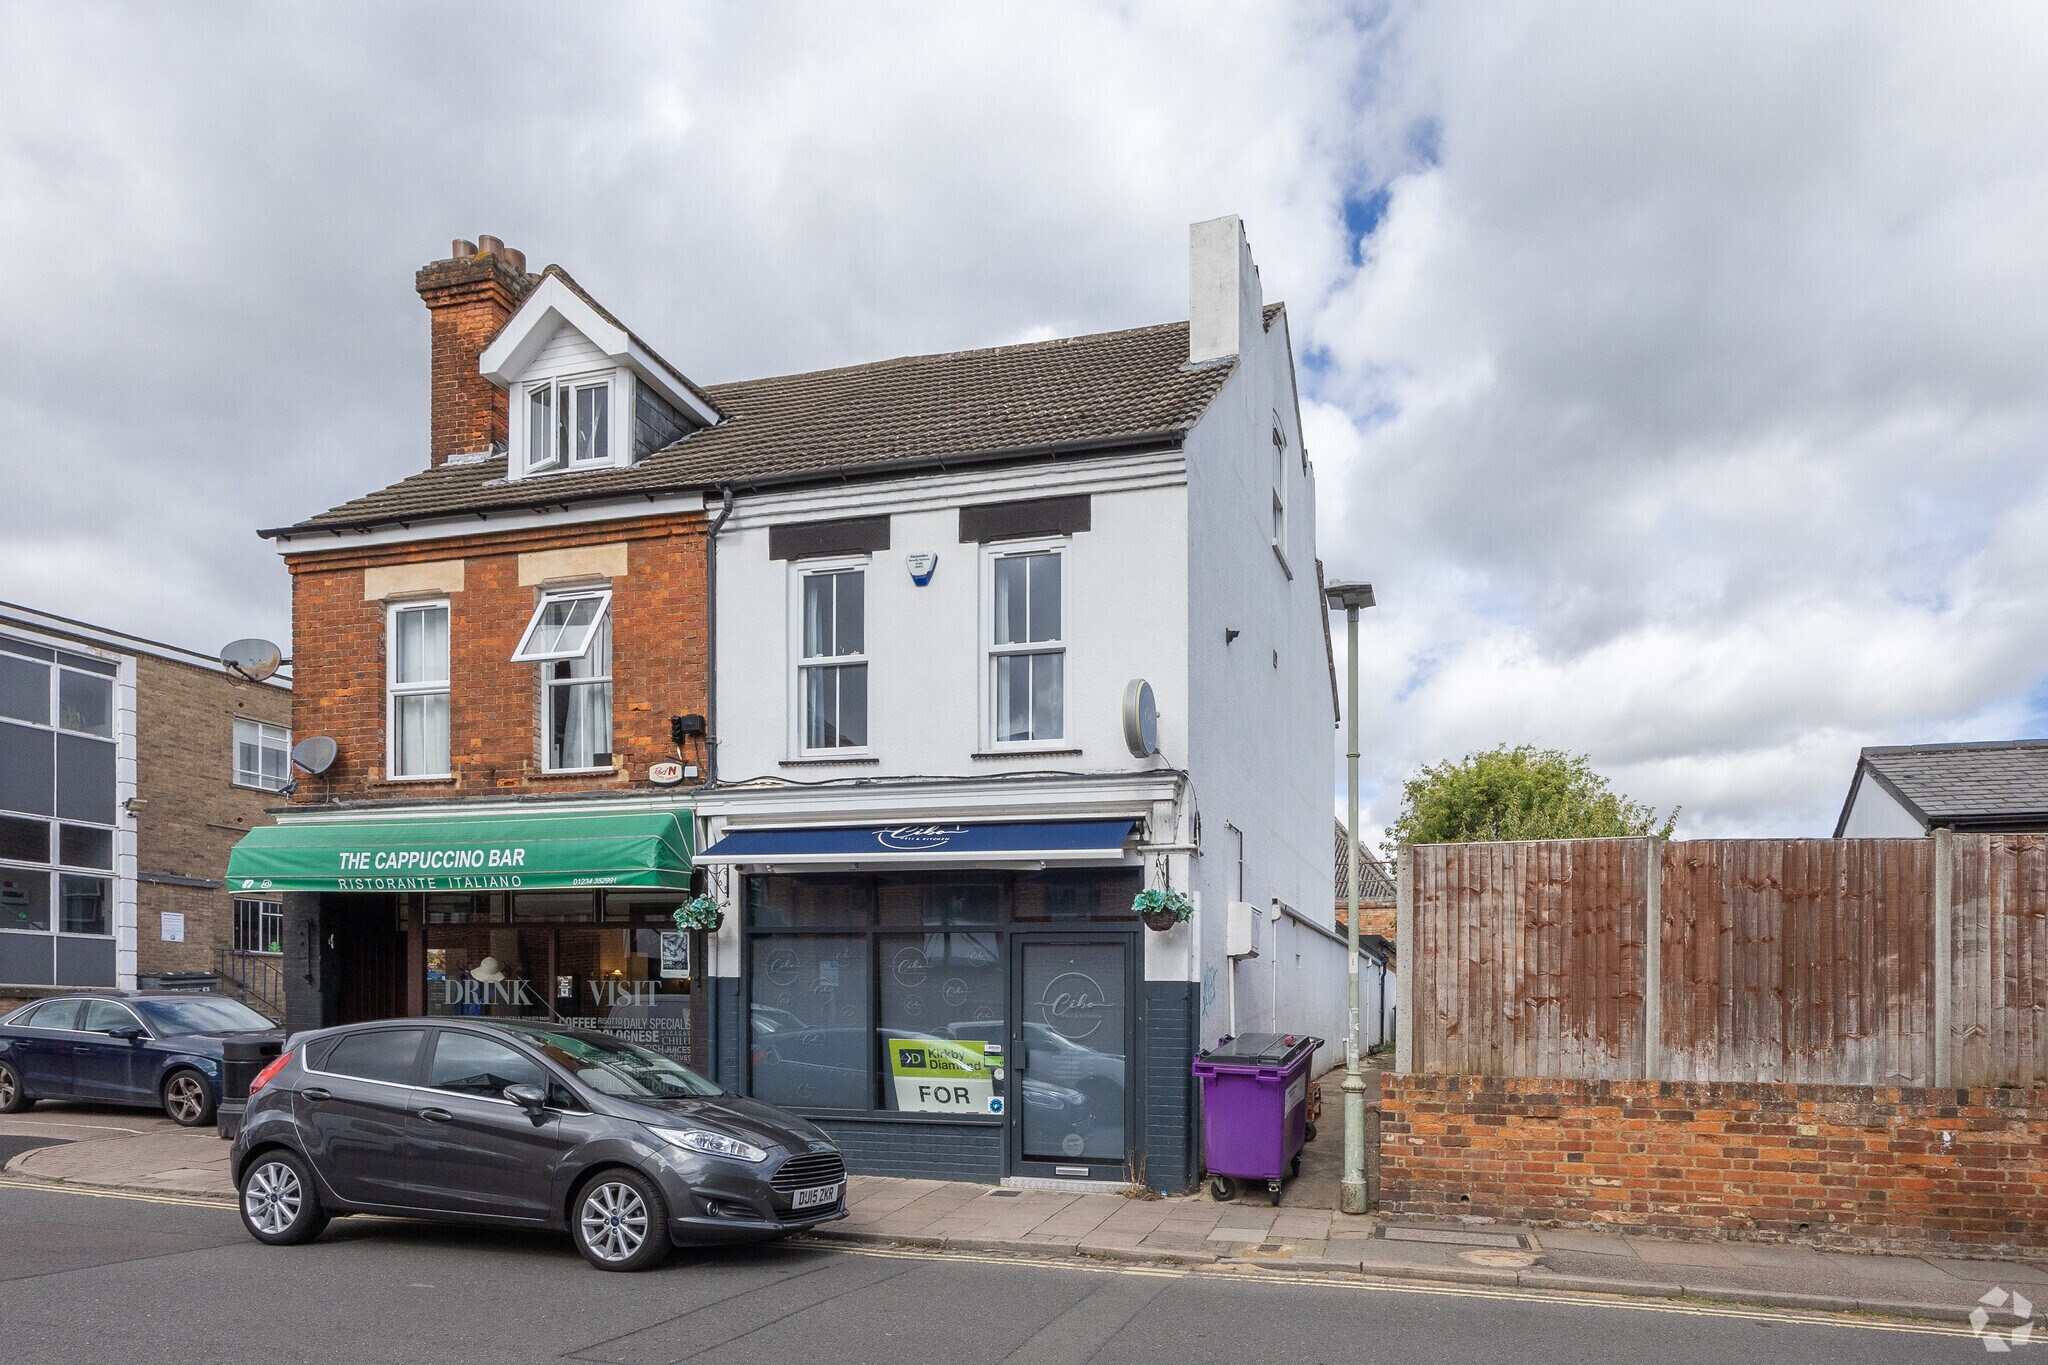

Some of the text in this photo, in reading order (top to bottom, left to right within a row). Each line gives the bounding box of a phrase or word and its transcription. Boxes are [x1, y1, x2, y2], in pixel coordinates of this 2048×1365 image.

[339, 848, 525, 870] THE CAPPUCCINO BAR
[337, 875, 522, 890] RISTORANTE ITALIANO
[572, 878, 593, 886] 01234
[443, 979, 533, 1006] DRINK
[587, 980, 662, 1007] VISIT
[598, 1017, 623, 1025] RISOTTO
[623, 1017, 690, 1030] DAILY SPECIALS
[661, 1037, 690, 1045] CHILLI
[928, 1049, 965, 1061] Kirkby
[919, 1086, 970, 1104] FOR
